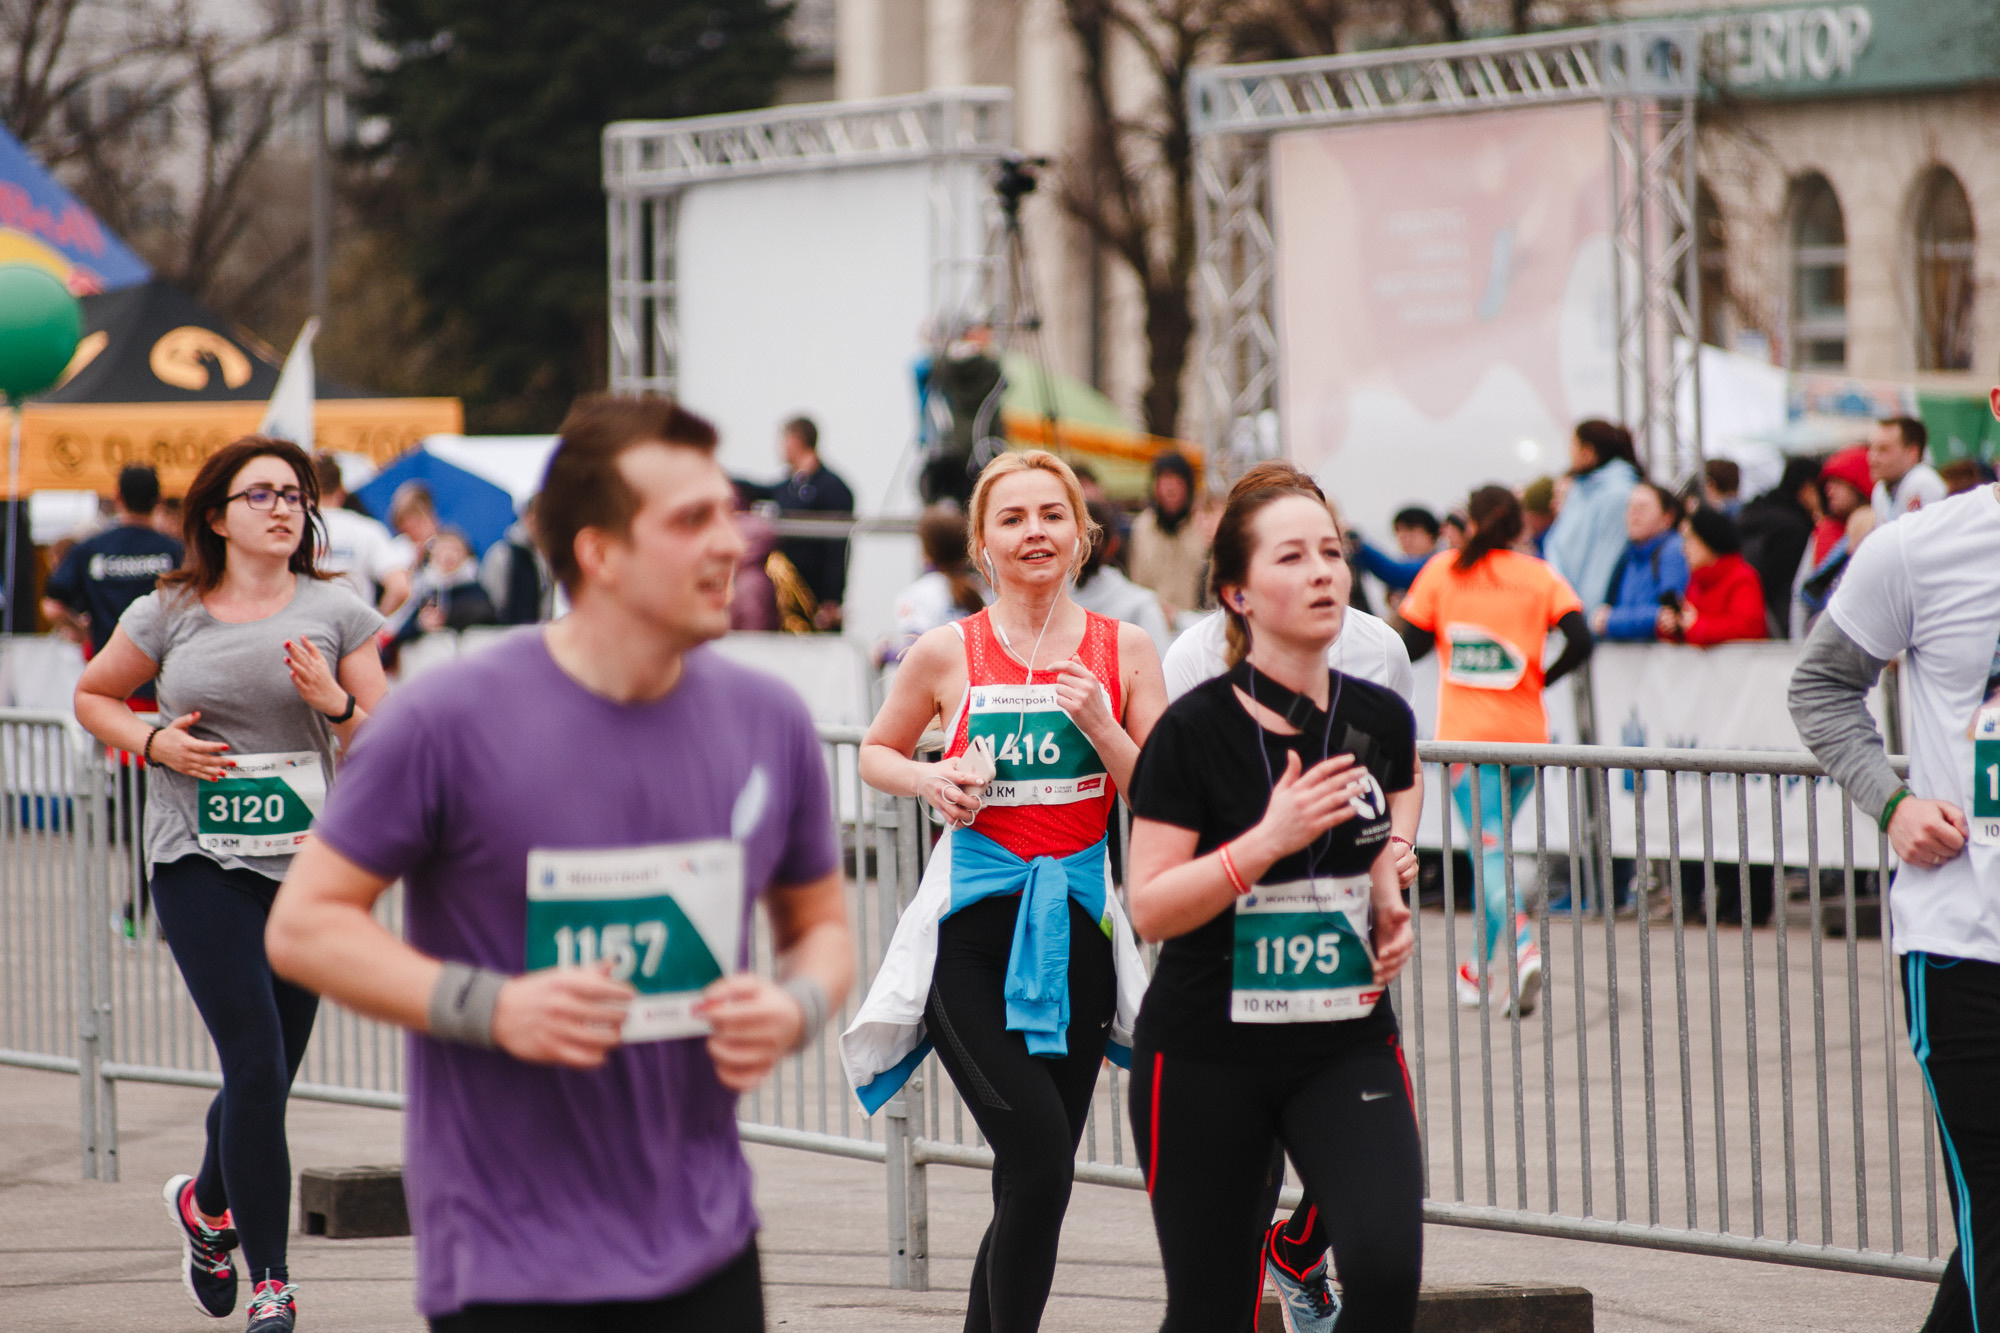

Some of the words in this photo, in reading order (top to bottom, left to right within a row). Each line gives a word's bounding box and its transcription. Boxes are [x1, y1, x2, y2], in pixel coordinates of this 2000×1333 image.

[991, 696, 1054, 705] Жилстрой-1
[985, 732, 1060, 765] 1416
[997, 786, 1015, 798] KM
[208, 794, 284, 823] 3120
[1985, 824, 1999, 837] 10
[221, 838, 240, 848] KM
[554, 919, 669, 981] 1157
[1254, 932, 1341, 975] 1195
[1244, 999, 1259, 1013] 10
[1265, 999, 1289, 1013] KM
